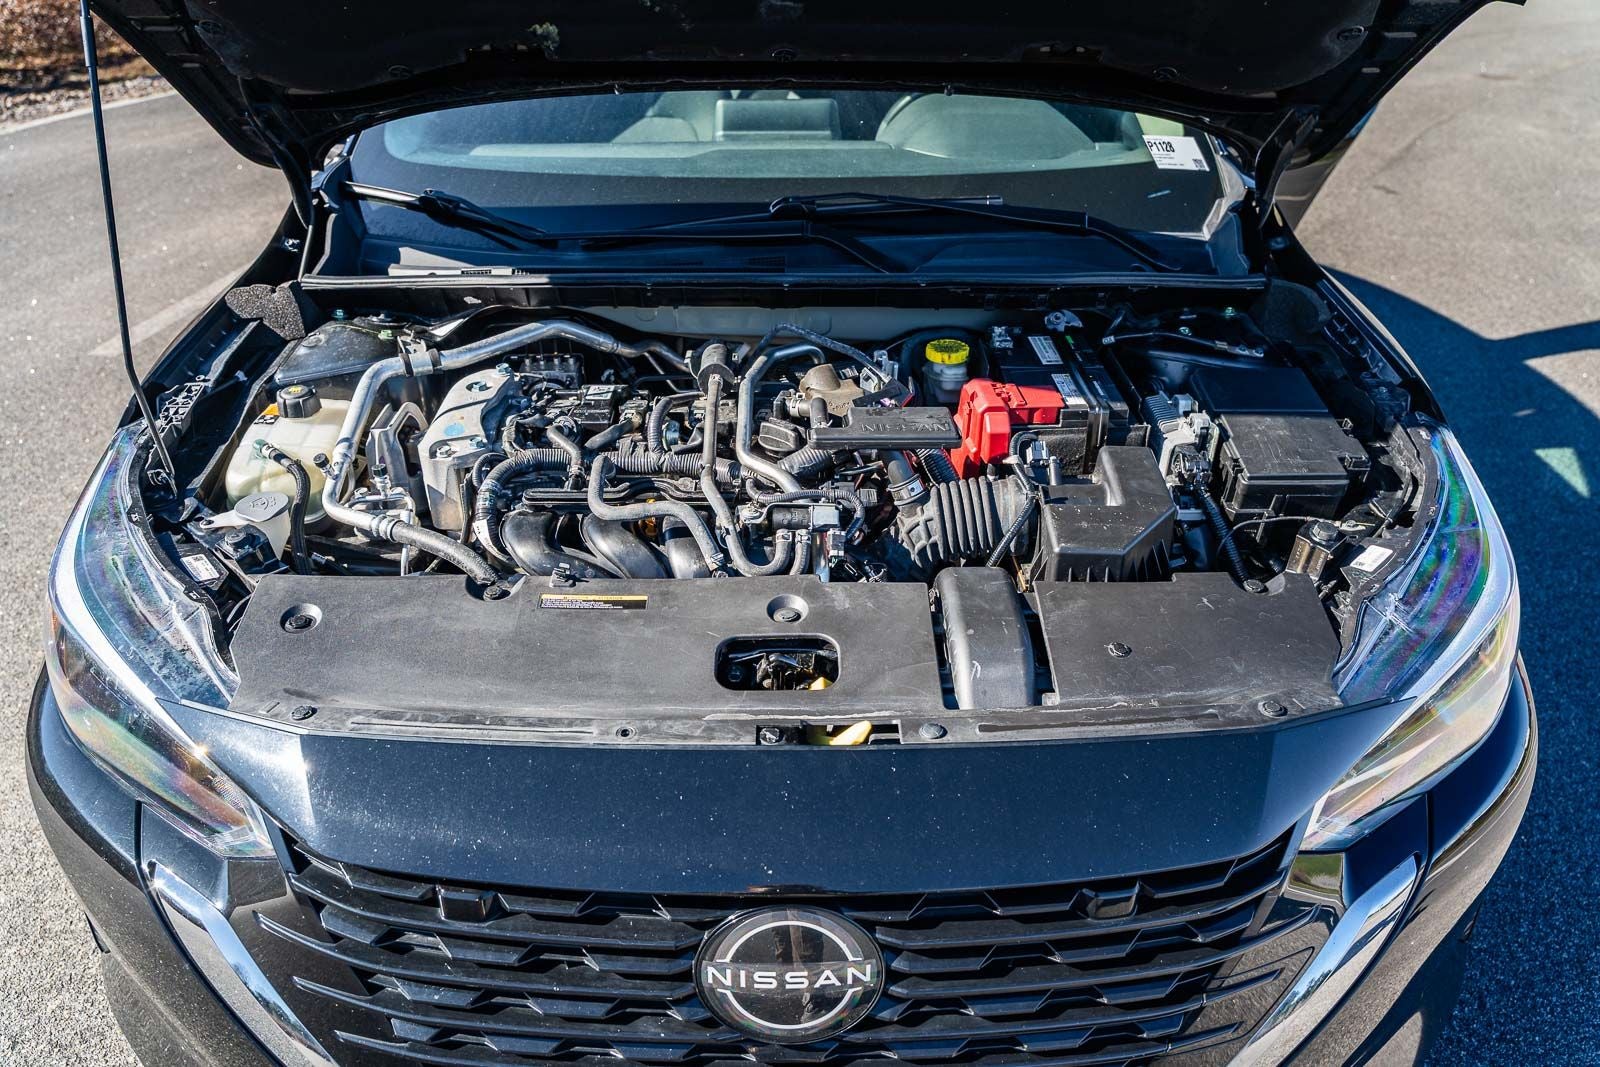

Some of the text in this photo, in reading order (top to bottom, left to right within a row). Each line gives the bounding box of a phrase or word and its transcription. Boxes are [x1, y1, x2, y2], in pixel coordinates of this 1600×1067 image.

[1146, 140, 1175, 152] P1128
[861, 422, 950, 432] NISSAN
[706, 964, 872, 989] NISSAN
